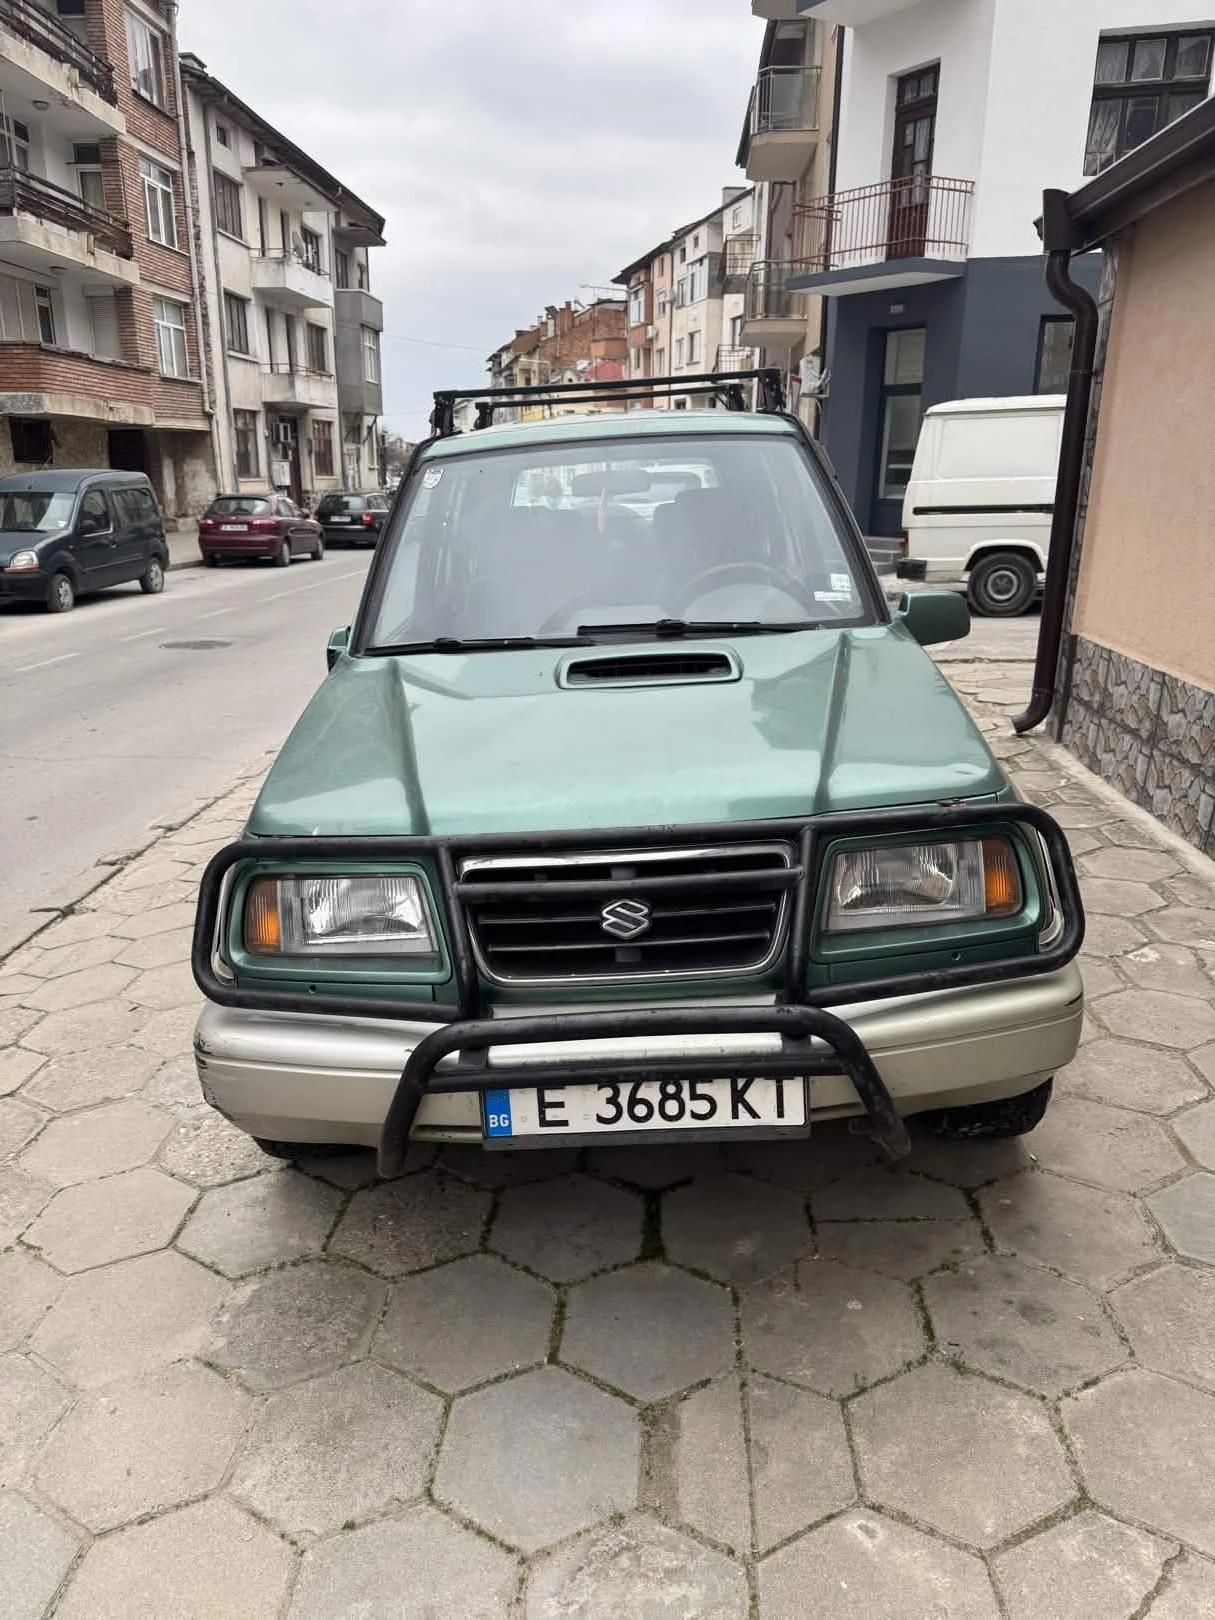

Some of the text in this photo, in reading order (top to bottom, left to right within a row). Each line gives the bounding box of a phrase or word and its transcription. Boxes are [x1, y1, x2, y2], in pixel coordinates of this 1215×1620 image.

[488, 1077, 795, 1128] BG E 3685 KT
